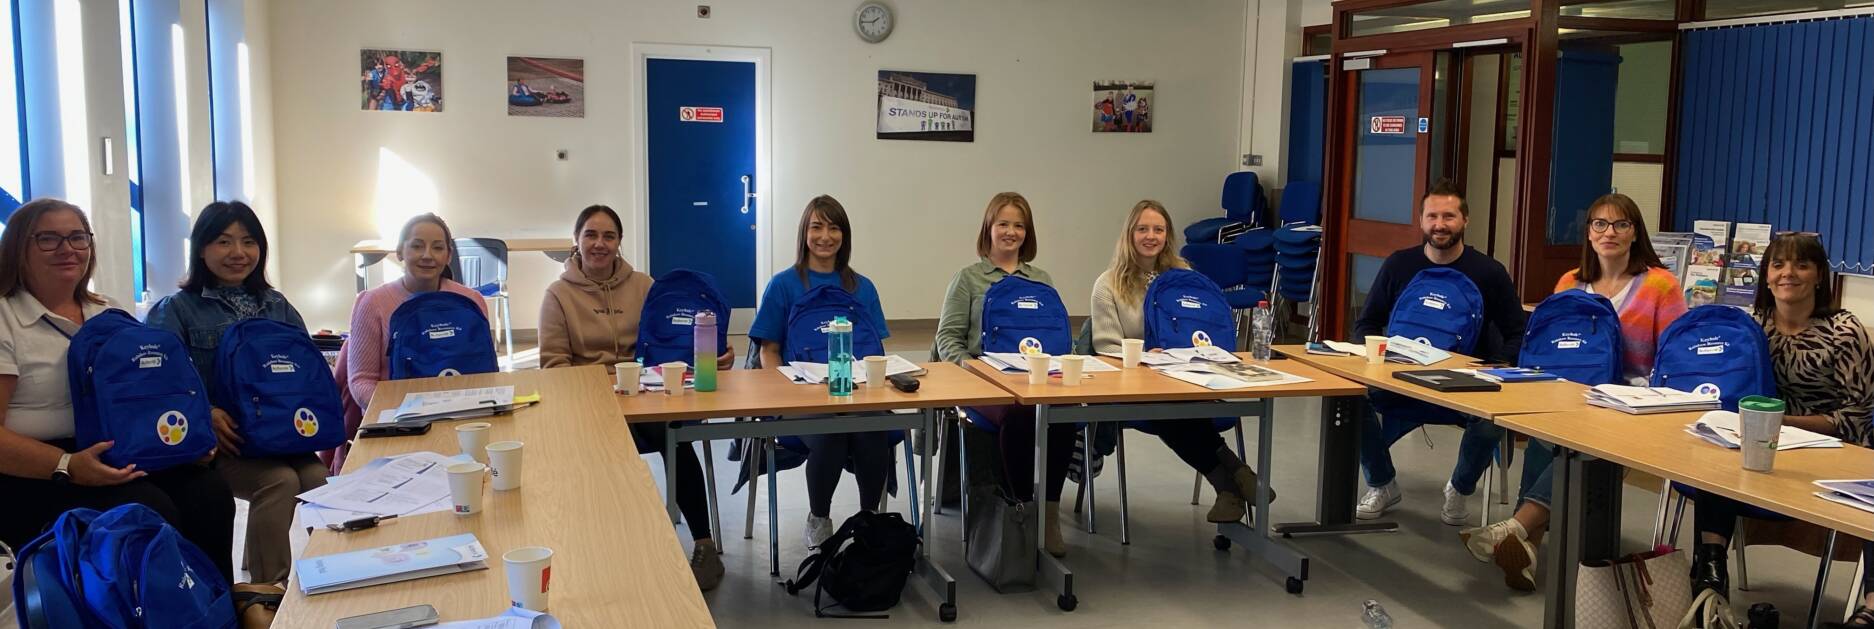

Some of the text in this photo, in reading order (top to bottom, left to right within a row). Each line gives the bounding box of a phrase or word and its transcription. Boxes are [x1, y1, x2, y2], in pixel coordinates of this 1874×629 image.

[888, 107, 927, 118] STANDS
[928, 111, 939, 119] UP
[940, 112, 952, 120] FOR
